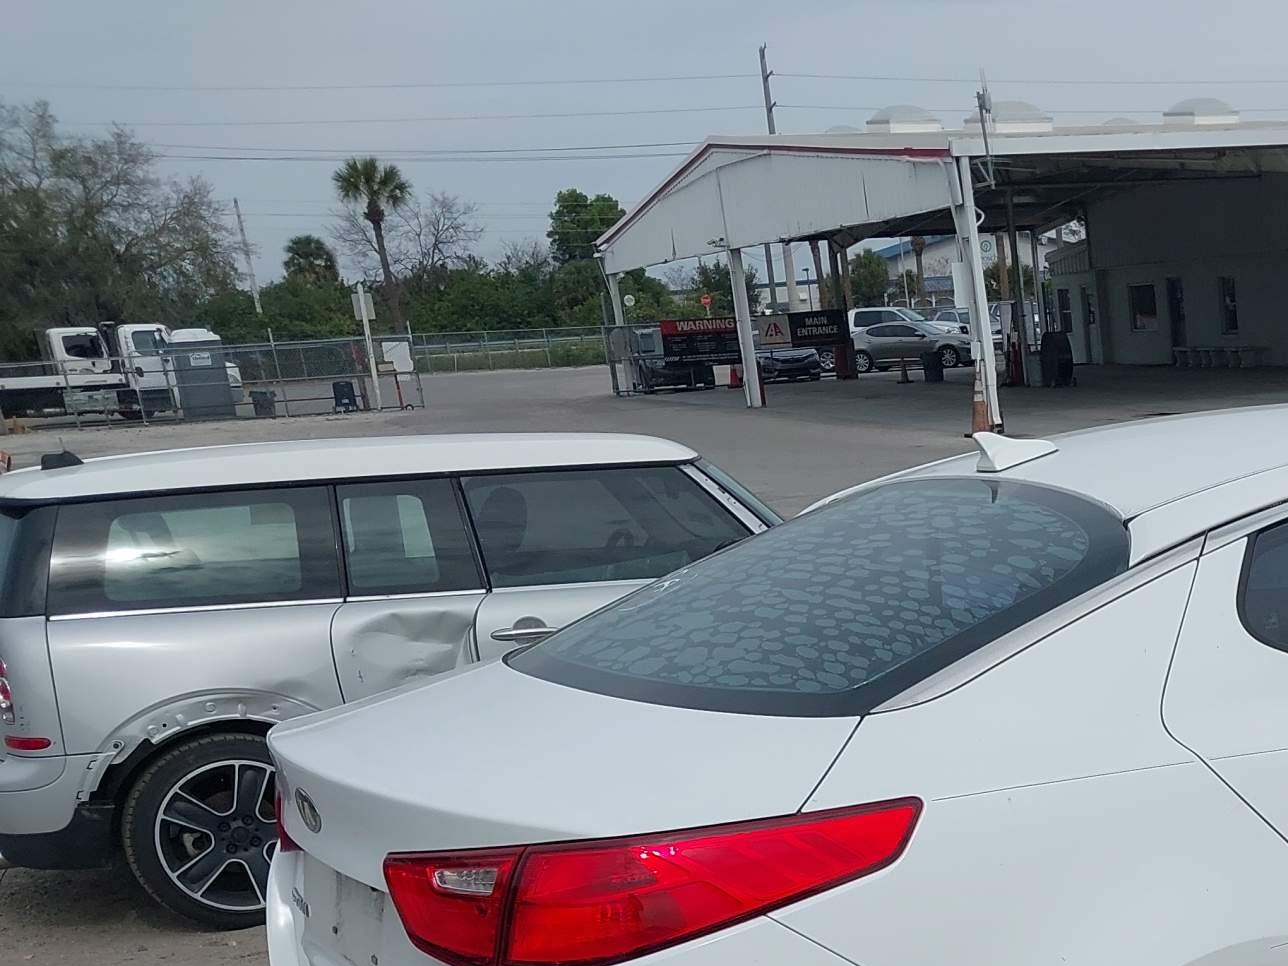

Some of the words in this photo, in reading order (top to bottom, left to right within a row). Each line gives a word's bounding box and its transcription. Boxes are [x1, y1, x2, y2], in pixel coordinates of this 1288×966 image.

[675, 318, 736, 332] WARNING
[804, 315, 828, 326] MAIN
[796, 325, 840, 337] ENTRANCE
